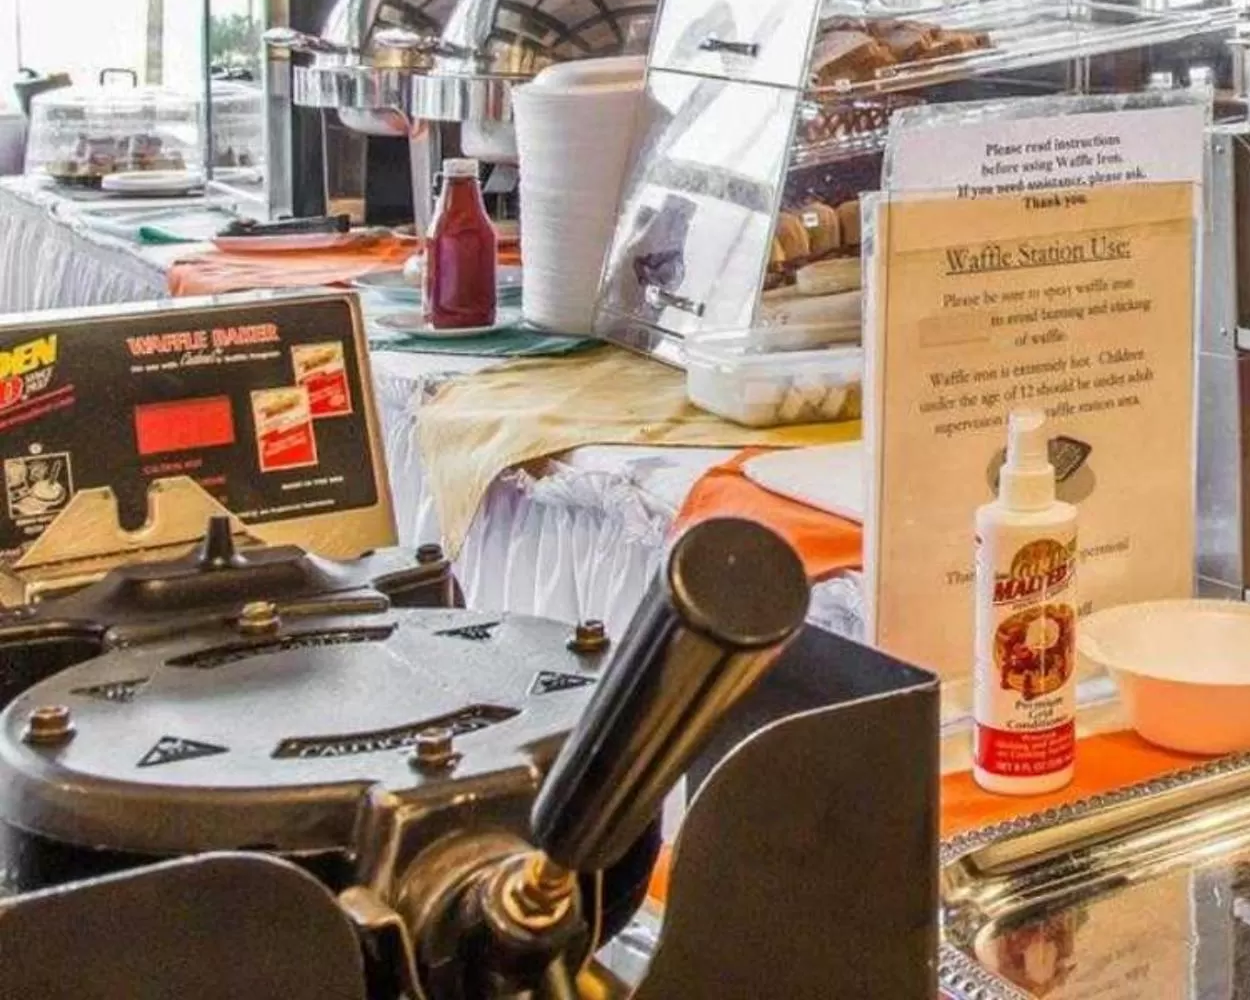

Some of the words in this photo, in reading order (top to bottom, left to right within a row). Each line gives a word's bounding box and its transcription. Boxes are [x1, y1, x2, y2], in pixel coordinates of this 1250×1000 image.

[986, 143, 1022, 157] Please
[1025, 140, 1051, 153] read
[1053, 135, 1121, 151] instructions
[981, 162, 1019, 177] before
[1022, 159, 1053, 174] using
[1056, 153, 1093, 169] Waffle
[957, 184, 968, 198] If
[971, 185, 993, 200] you
[996, 179, 1025, 194] need
[1088, 170, 1123, 187] please
[1024, 194, 1061, 209] Thank
[946, 243, 1013, 272] Waffle
[1015, 239, 1085, 266] Station
[1090, 236, 1131, 259] Use:
[943, 291, 980, 308] Please
[983, 289, 998, 303] be
[1001, 290, 1025, 301] sure
[1028, 287, 1040, 299] to
[1075, 278, 1108, 294] waffle
[1112, 278, 1134, 291] iron
[991, 314, 1004, 326] to
[1007, 309, 1038, 324] avoid
[1041, 306, 1085, 321] burning
[1087, 302, 1108, 315] and
[1110, 298, 1151, 313] sticking
[126, 330, 209, 356] WAFFLE
[212, 322, 281, 347] BAKER
[1014, 332, 1028, 347] of
[929, 368, 970, 388] Waffle
[973, 369, 998, 384] iron
[1001, 367, 1010, 379] is
[1012, 356, 1067, 378] extremely
[1098, 348, 1144, 366] Children
[919, 395, 955, 412] under
[959, 393, 978, 408] the
[981, 393, 1001, 409] age
[1003, 384, 1018, 402] of
[1019, 384, 1035, 398] 12
[1036, 379, 1075, 395] should
[1077, 376, 1092, 390] be
[1093, 372, 1125, 389] under
[934, 415, 1003, 437] supervision
[1079, 397, 1115, 413] station
[993, 563, 1069, 602] MALTED
